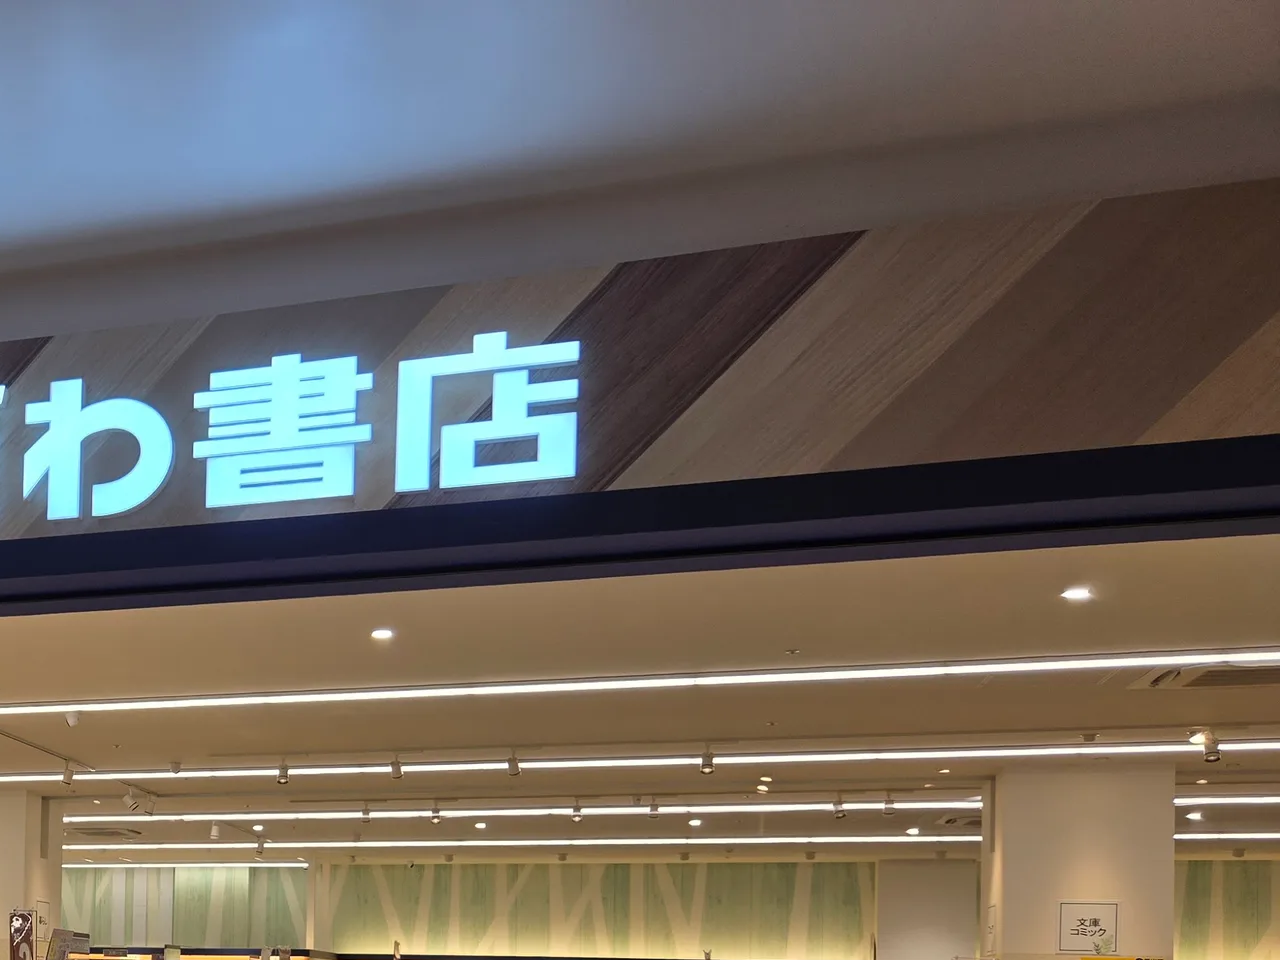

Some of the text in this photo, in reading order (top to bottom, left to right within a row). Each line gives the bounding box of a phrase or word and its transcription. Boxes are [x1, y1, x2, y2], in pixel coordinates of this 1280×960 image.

[1076, 917, 1101, 928] 文庫
[1069, 927, 1108, 938] コミック
